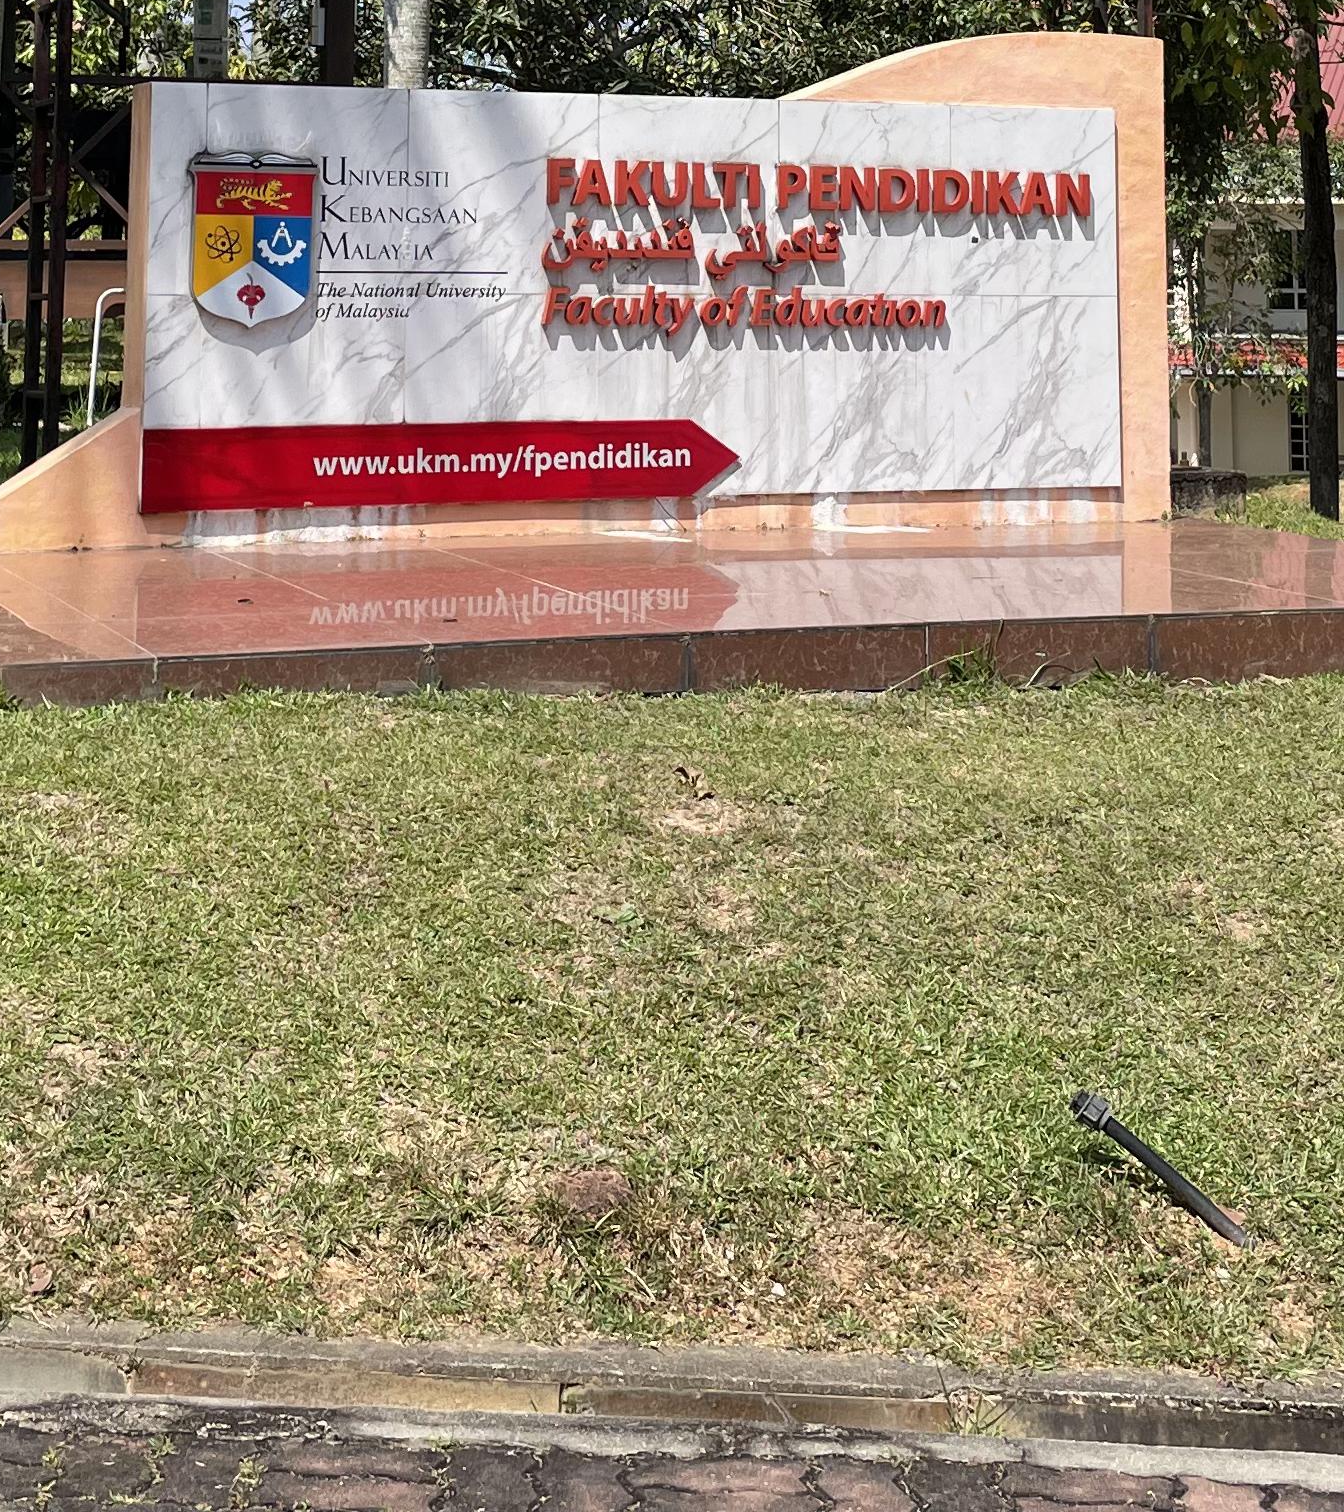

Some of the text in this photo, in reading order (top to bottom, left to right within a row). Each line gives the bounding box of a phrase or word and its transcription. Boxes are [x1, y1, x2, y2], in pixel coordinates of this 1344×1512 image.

[320, 155, 450, 188] UNIVERSITI
[546, 158, 1092, 217] FAKULTI PENDIDIKAN
[320, 194, 478, 224] KEBANGSAAN
[317, 231, 434, 261] MALAYIA
[317, 281, 507, 302] The National University
[315, 302, 410, 322] of Malaysia
[541, 285, 947, 336] Faculty of Education
[312, 442, 692, 479] www.ukm.my/fpendidikan
